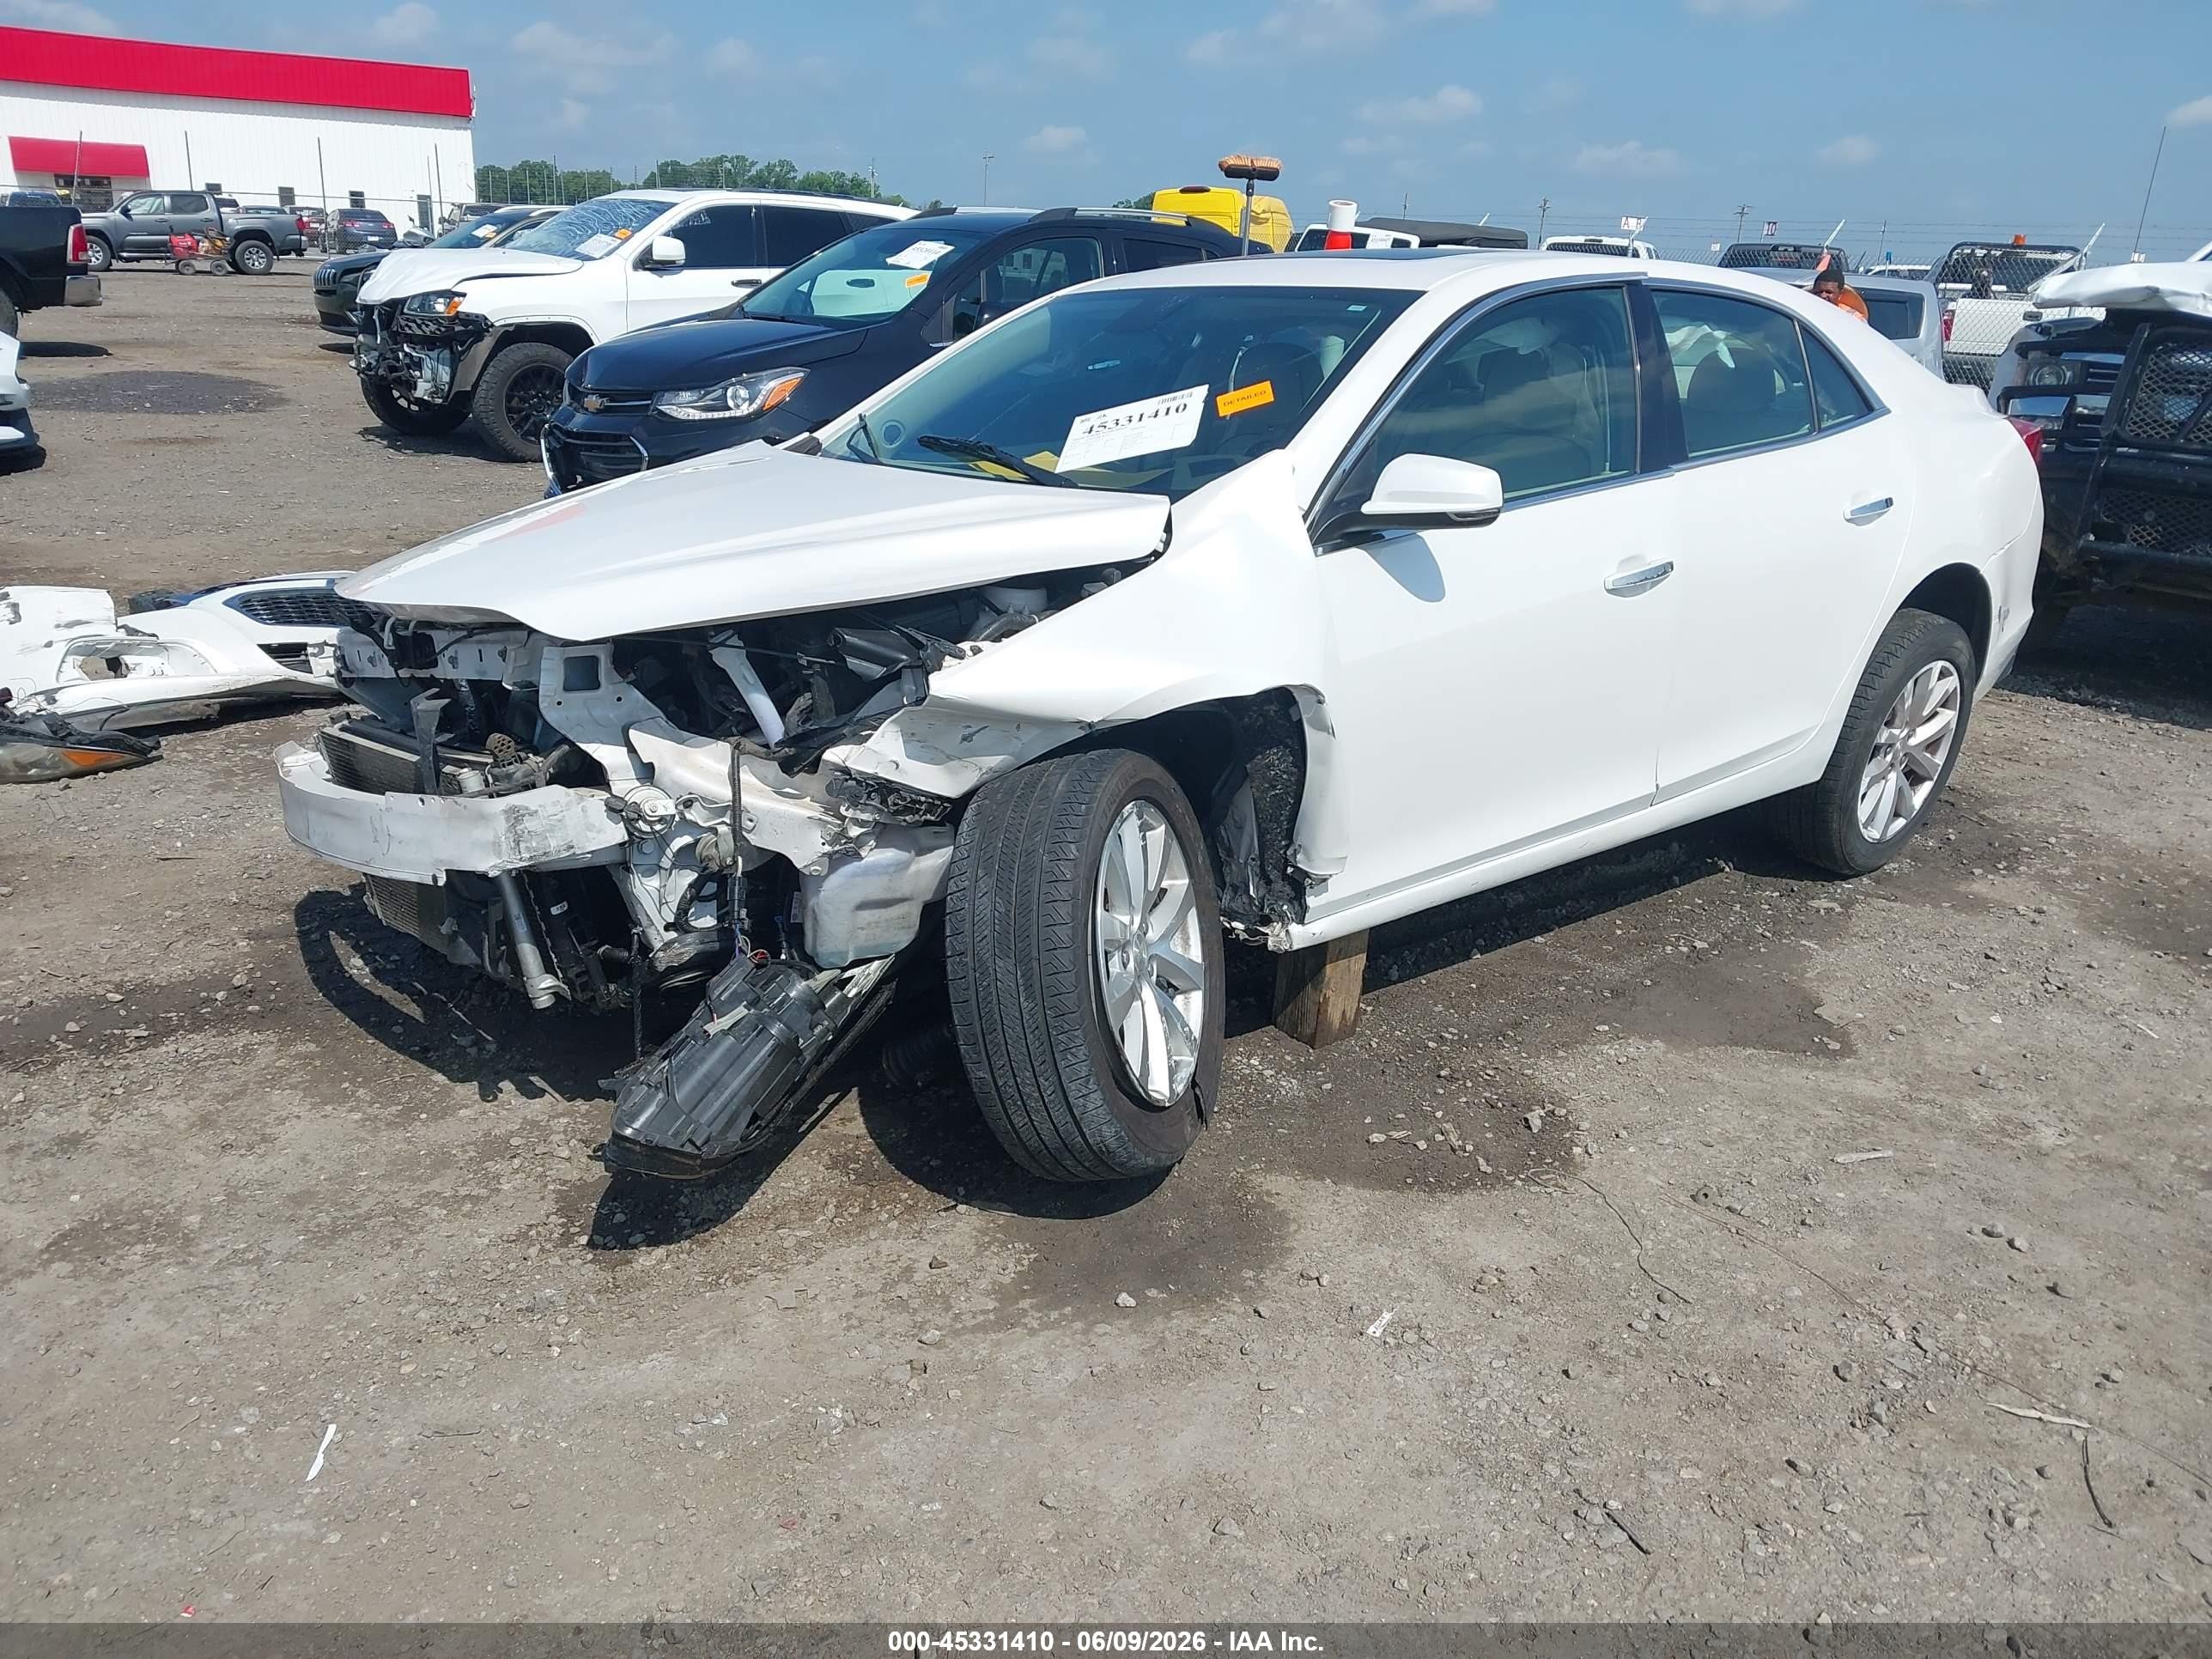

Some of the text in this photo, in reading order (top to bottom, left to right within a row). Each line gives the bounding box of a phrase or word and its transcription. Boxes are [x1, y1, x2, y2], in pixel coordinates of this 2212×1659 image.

[1622, 216, 1630, 228] A
[1223, 390, 1267, 407] DETAILED
[1082, 403, 1188, 435] 45331410
